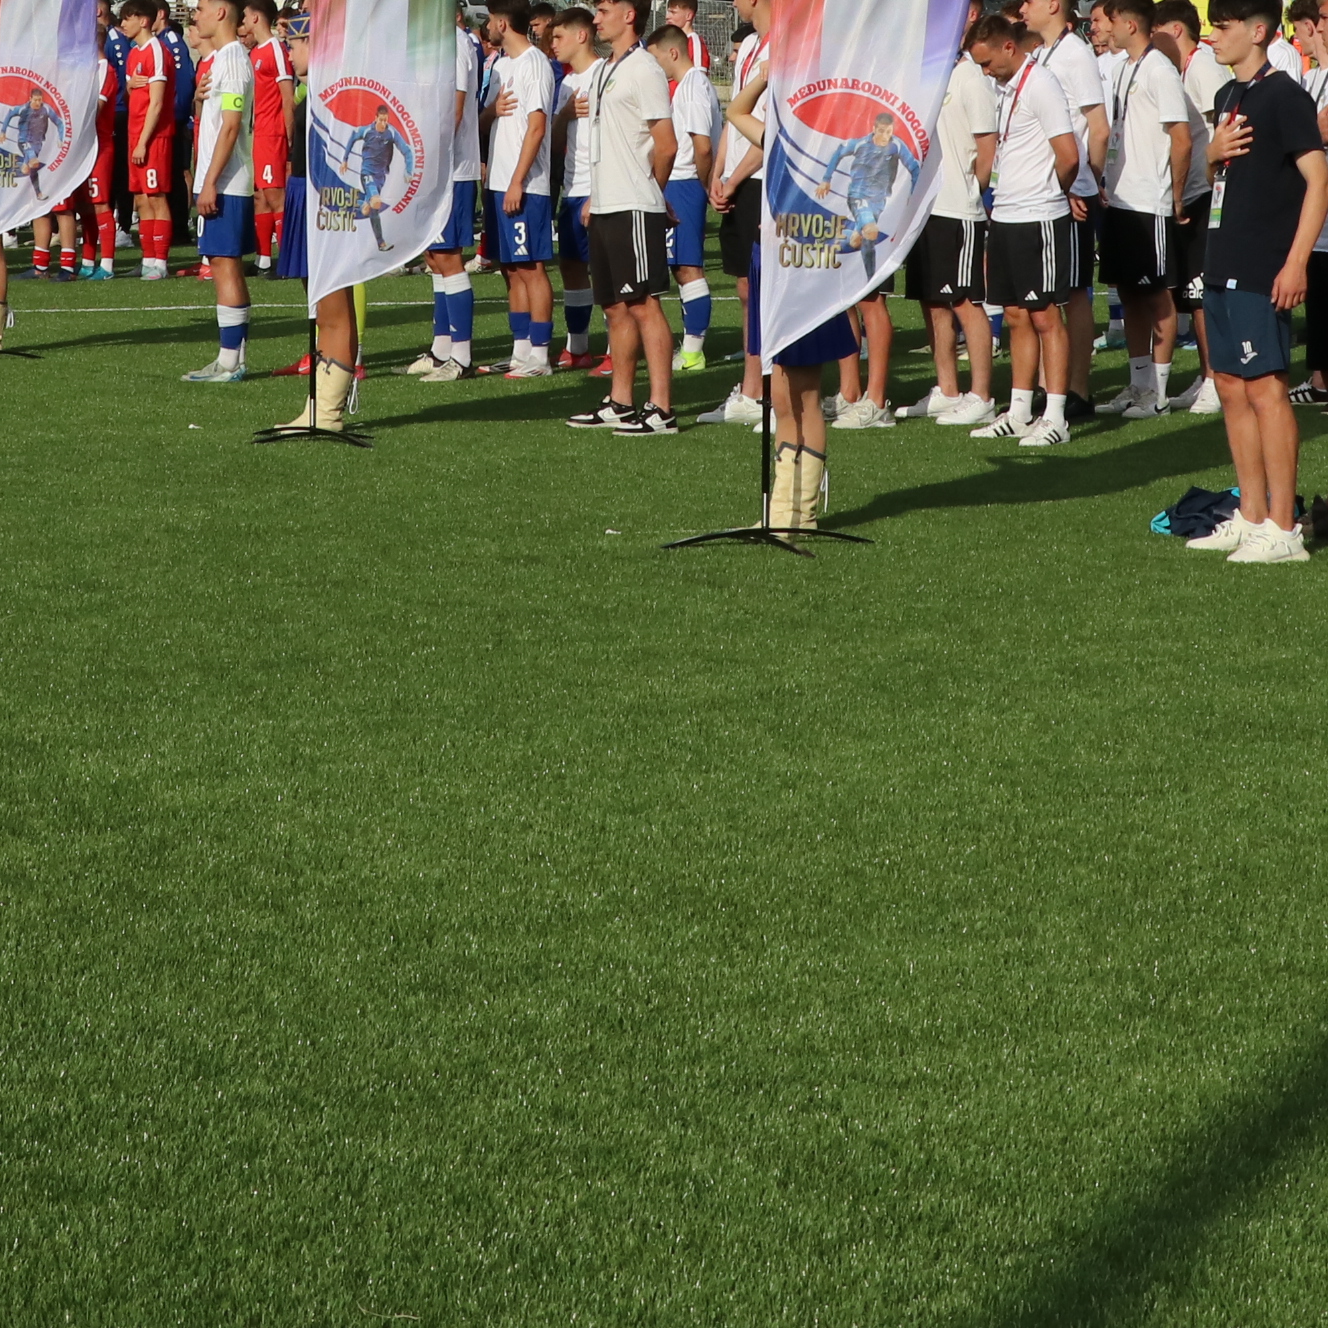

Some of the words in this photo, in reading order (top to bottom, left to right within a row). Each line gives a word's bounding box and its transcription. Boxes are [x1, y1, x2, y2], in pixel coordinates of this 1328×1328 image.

[232, 97, 243, 109] C
[786, 77, 899, 108] MEĐUNARODNI
[390, 95, 425, 170] NOGOMETNI
[47, 140, 72, 173] TURNIR
[146, 168, 158, 189] 8
[262, 164, 273, 184] 4
[88, 177, 99, 198] 5
[392, 171, 424, 215] TURNIR
[514, 222, 527, 245] 3
[775, 212, 849, 241] HRVOJE
[778, 237, 842, 269] ČUSTIĆ
[1241, 340, 1253, 355] 10
